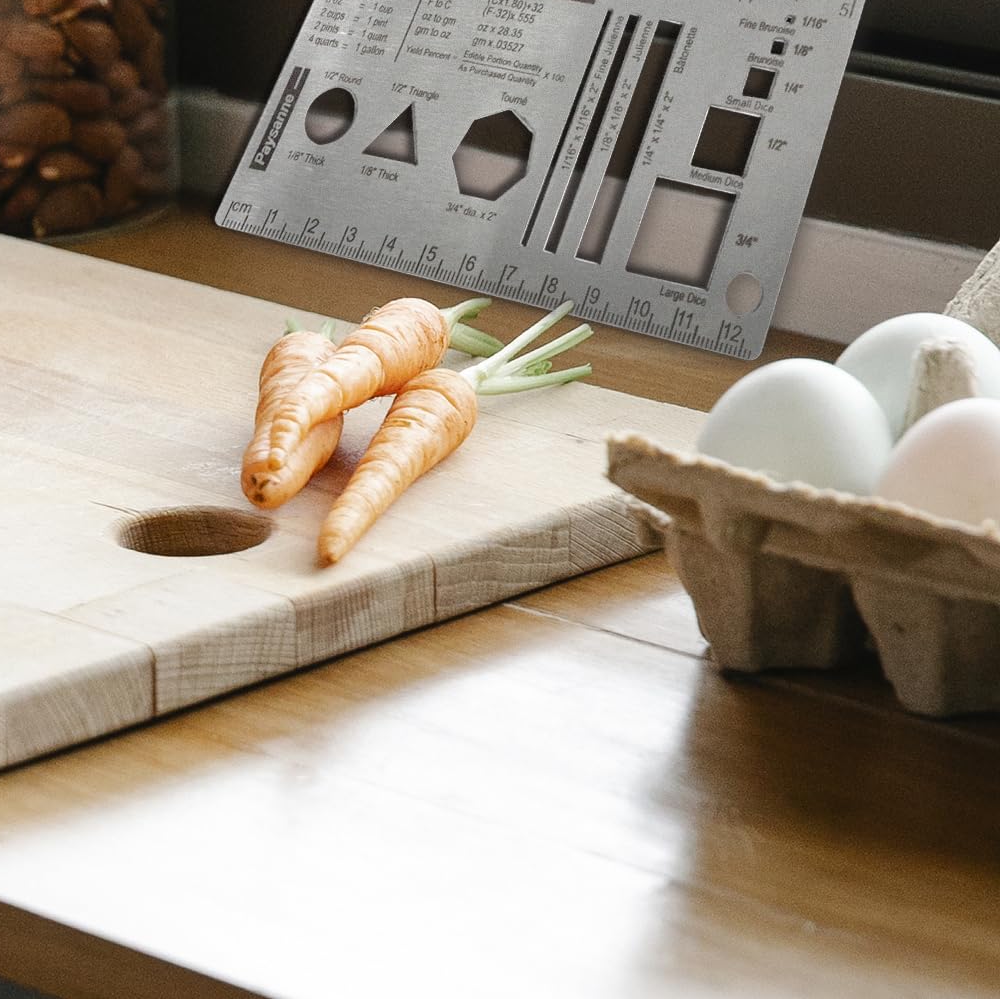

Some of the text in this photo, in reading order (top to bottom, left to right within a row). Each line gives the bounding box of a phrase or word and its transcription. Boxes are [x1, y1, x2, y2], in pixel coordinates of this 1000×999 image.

[435, 0, 443, 8] to
[444, 0, 452, 10] C
[839, 3, 849, 17] 5
[320, 8, 327, 17] 2
[327, 10, 346, 21] cups
[368, 16, 373, 25] 1
[422, 13, 457, 27] oz to gm
[314, 21, 321, 30] 2
[414, 26, 451, 39] gm to oz
[477, 24, 489, 32] oz
[739, 18, 796, 36] Fine Brunoise
[472, 37, 487, 47] gm
[632, 20, 654, 63] Julienne
[486, 55, 512, 66] Portion
[747, 52, 785, 68] Brunoise
[594, 59, 609, 80] Fine
[339, 73, 363, 86] Round
[409, 86, 440, 102] Triangle
[725, 95, 774, 113] Small Dice
[254, 93, 295, 165] Paysanne
[305, 153, 325, 167] Thick
[378, 168, 399, 182] Thick
[690, 169, 744, 189] Medium Dice
[232, 202, 743, 343] cm 1 2 3 4 5 6 7 8 9 10 11 12
[659, 285, 707, 307] Large Dice
